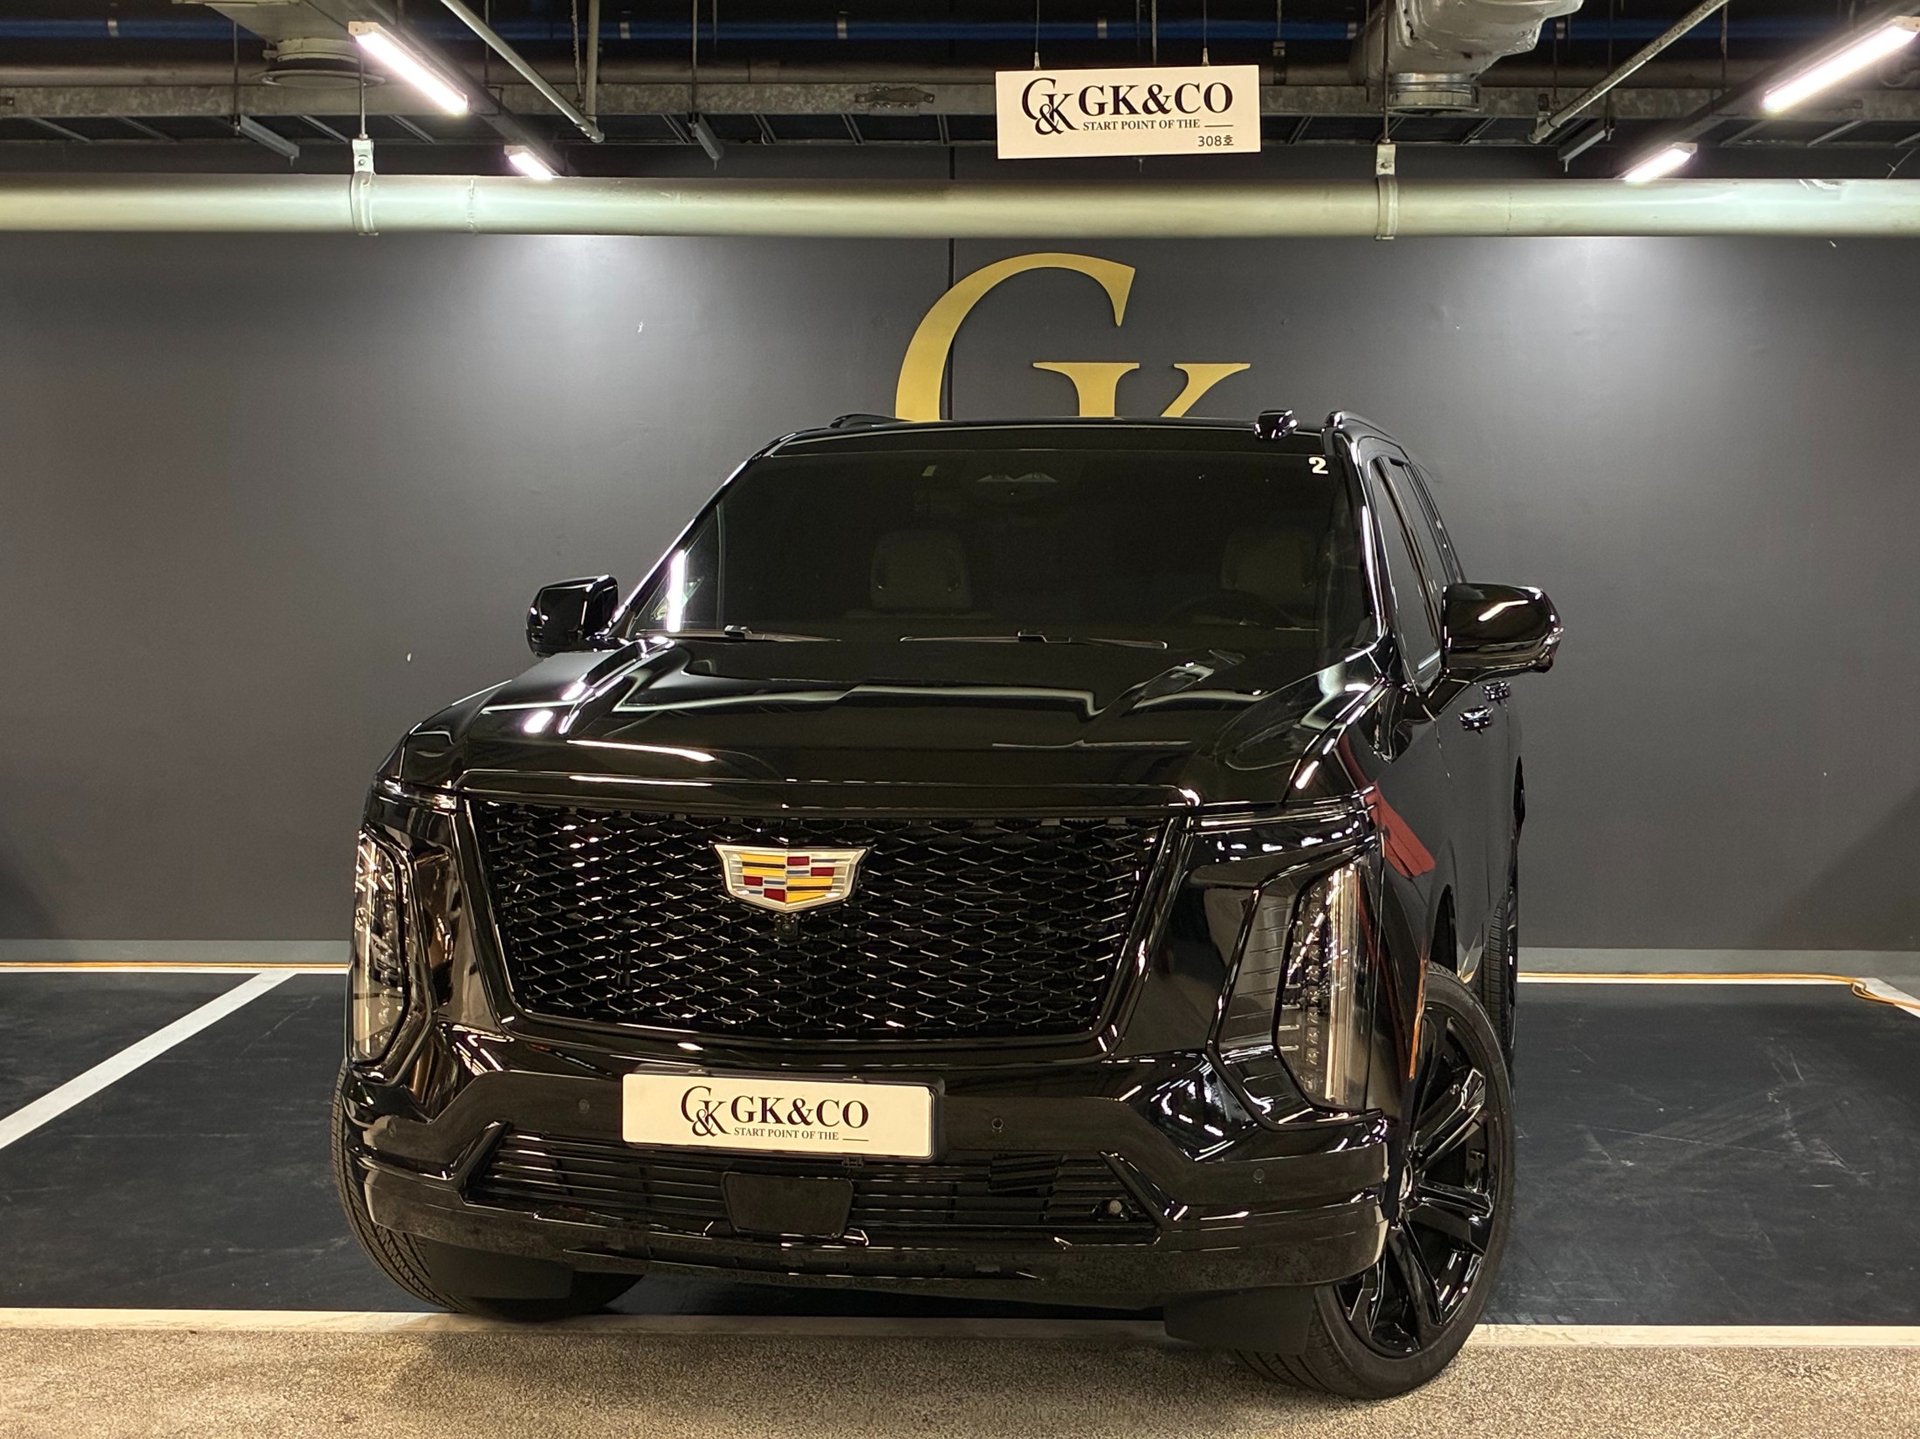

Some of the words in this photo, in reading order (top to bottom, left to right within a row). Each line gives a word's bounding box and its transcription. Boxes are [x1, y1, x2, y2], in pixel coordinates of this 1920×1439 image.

[1078, 82, 1233, 117] GK&CO
[1083, 120, 1118, 131] START
[1121, 119, 1156, 130] POINT
[1159, 119, 1175, 129] OF
[1178, 118, 1200, 129] THE
[1198, 135, 1234, 147] 308호
[1308, 456, 1329, 475] 2
[730, 1095, 869, 1129] GK&CO
[734, 1127, 764, 1137] START
[767, 1128, 798, 1139] POINT
[801, 1130, 816, 1140] OF
[818, 1131, 839, 1141] THE
